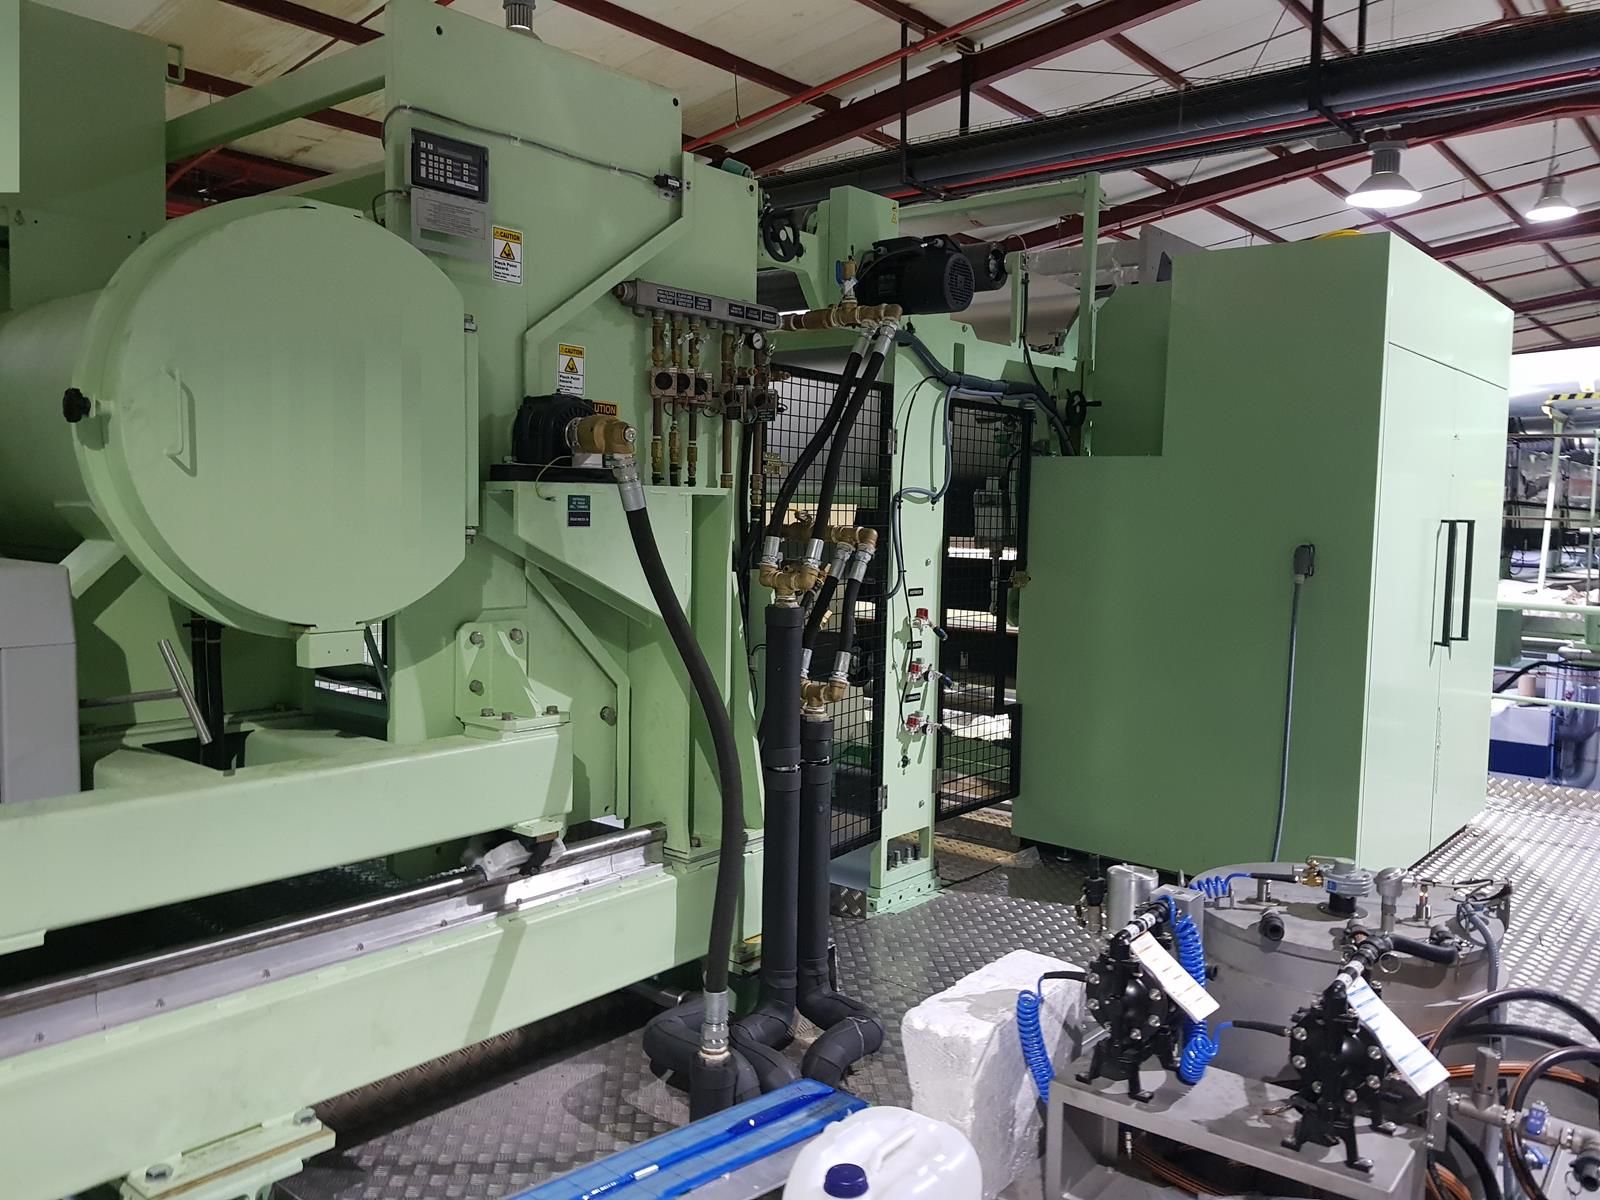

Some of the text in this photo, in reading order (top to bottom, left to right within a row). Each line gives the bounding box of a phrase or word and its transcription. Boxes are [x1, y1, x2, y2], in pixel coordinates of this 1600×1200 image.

[500, 231, 520, 241] CAUTION
[565, 347, 583, 356] CAUTION
[594, 404, 616, 415] UTION
